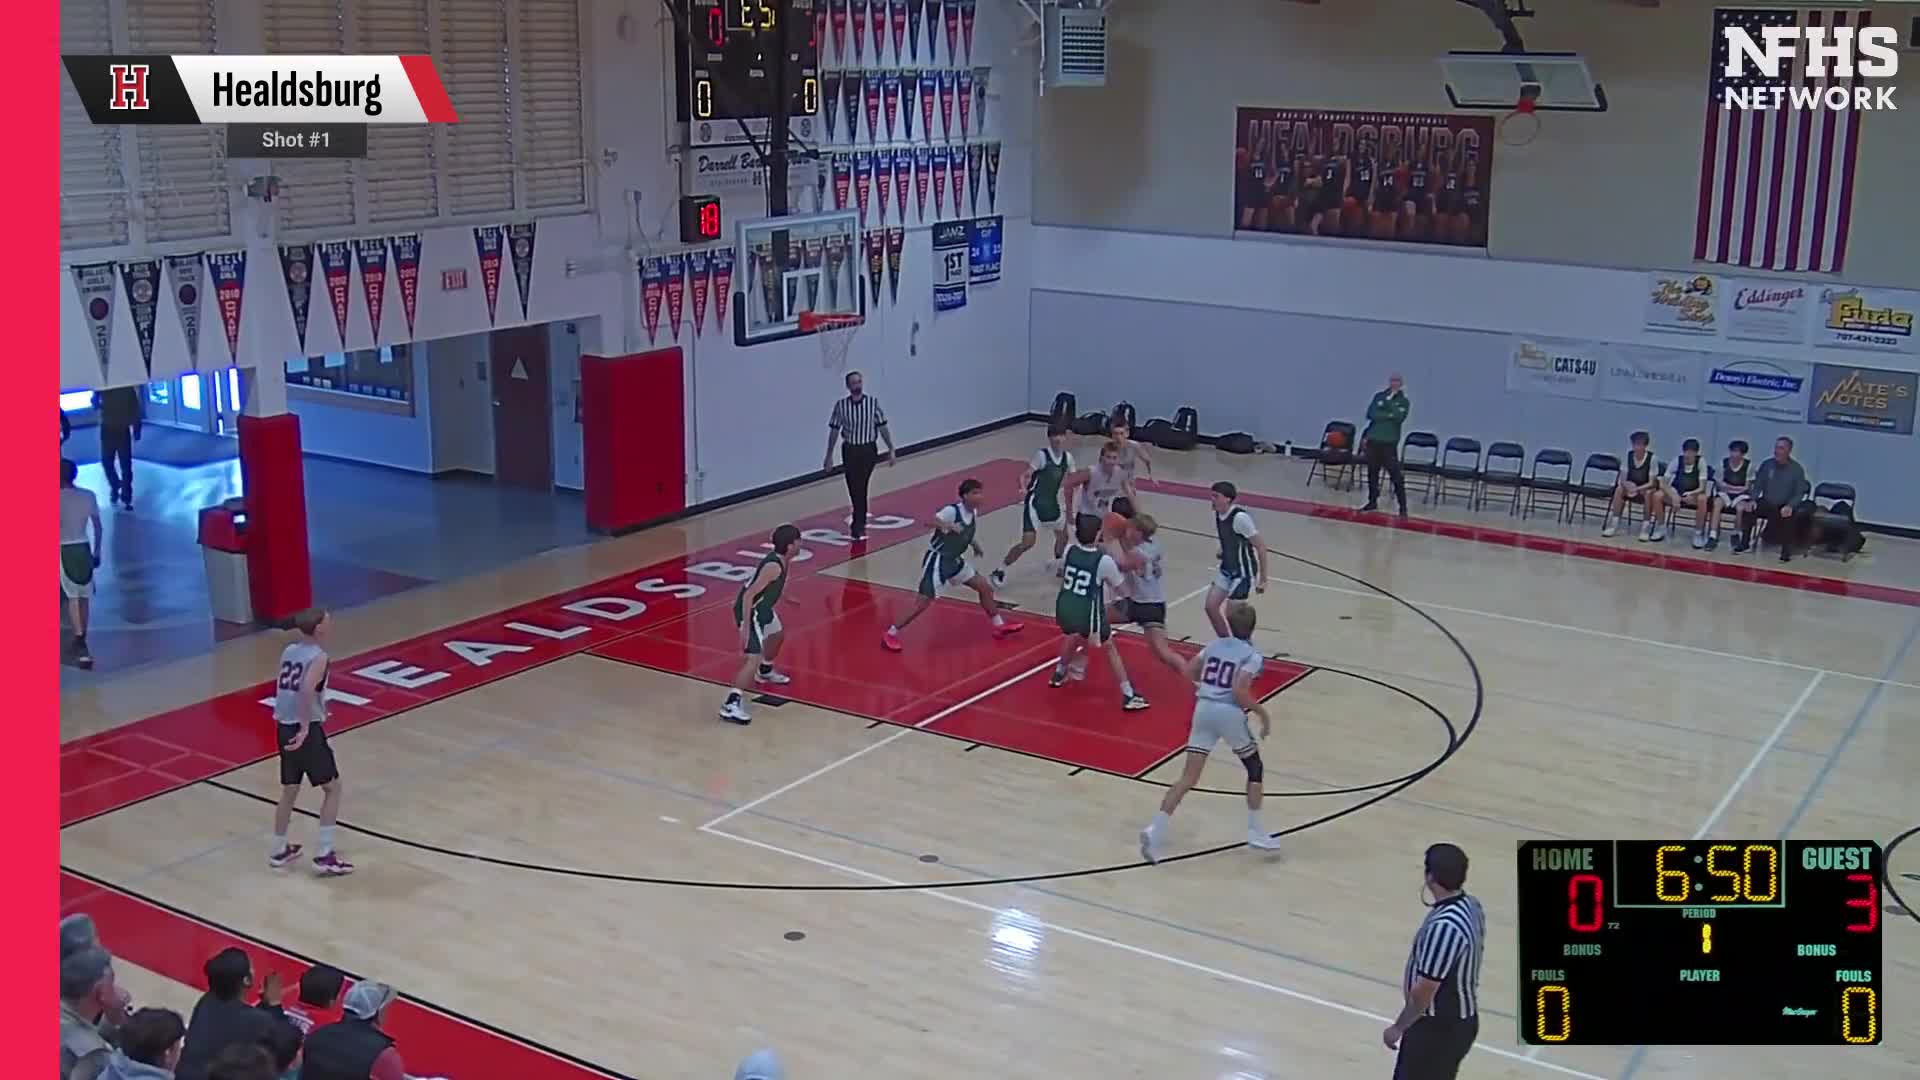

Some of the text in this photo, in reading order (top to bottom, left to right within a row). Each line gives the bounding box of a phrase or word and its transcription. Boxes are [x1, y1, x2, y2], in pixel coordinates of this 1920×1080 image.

[697, 81, 711, 117] 0
[944, 252, 964, 281] 1ST
[1554, 357, 1597, 376] CATS4U
[1815, 383, 1888, 409] NOTES
[1837, 369, 1909, 397] NATE'S
[1063, 565, 1092, 596] 52
[279, 660, 304, 692] 22
[1203, 656, 1236, 689] 20
